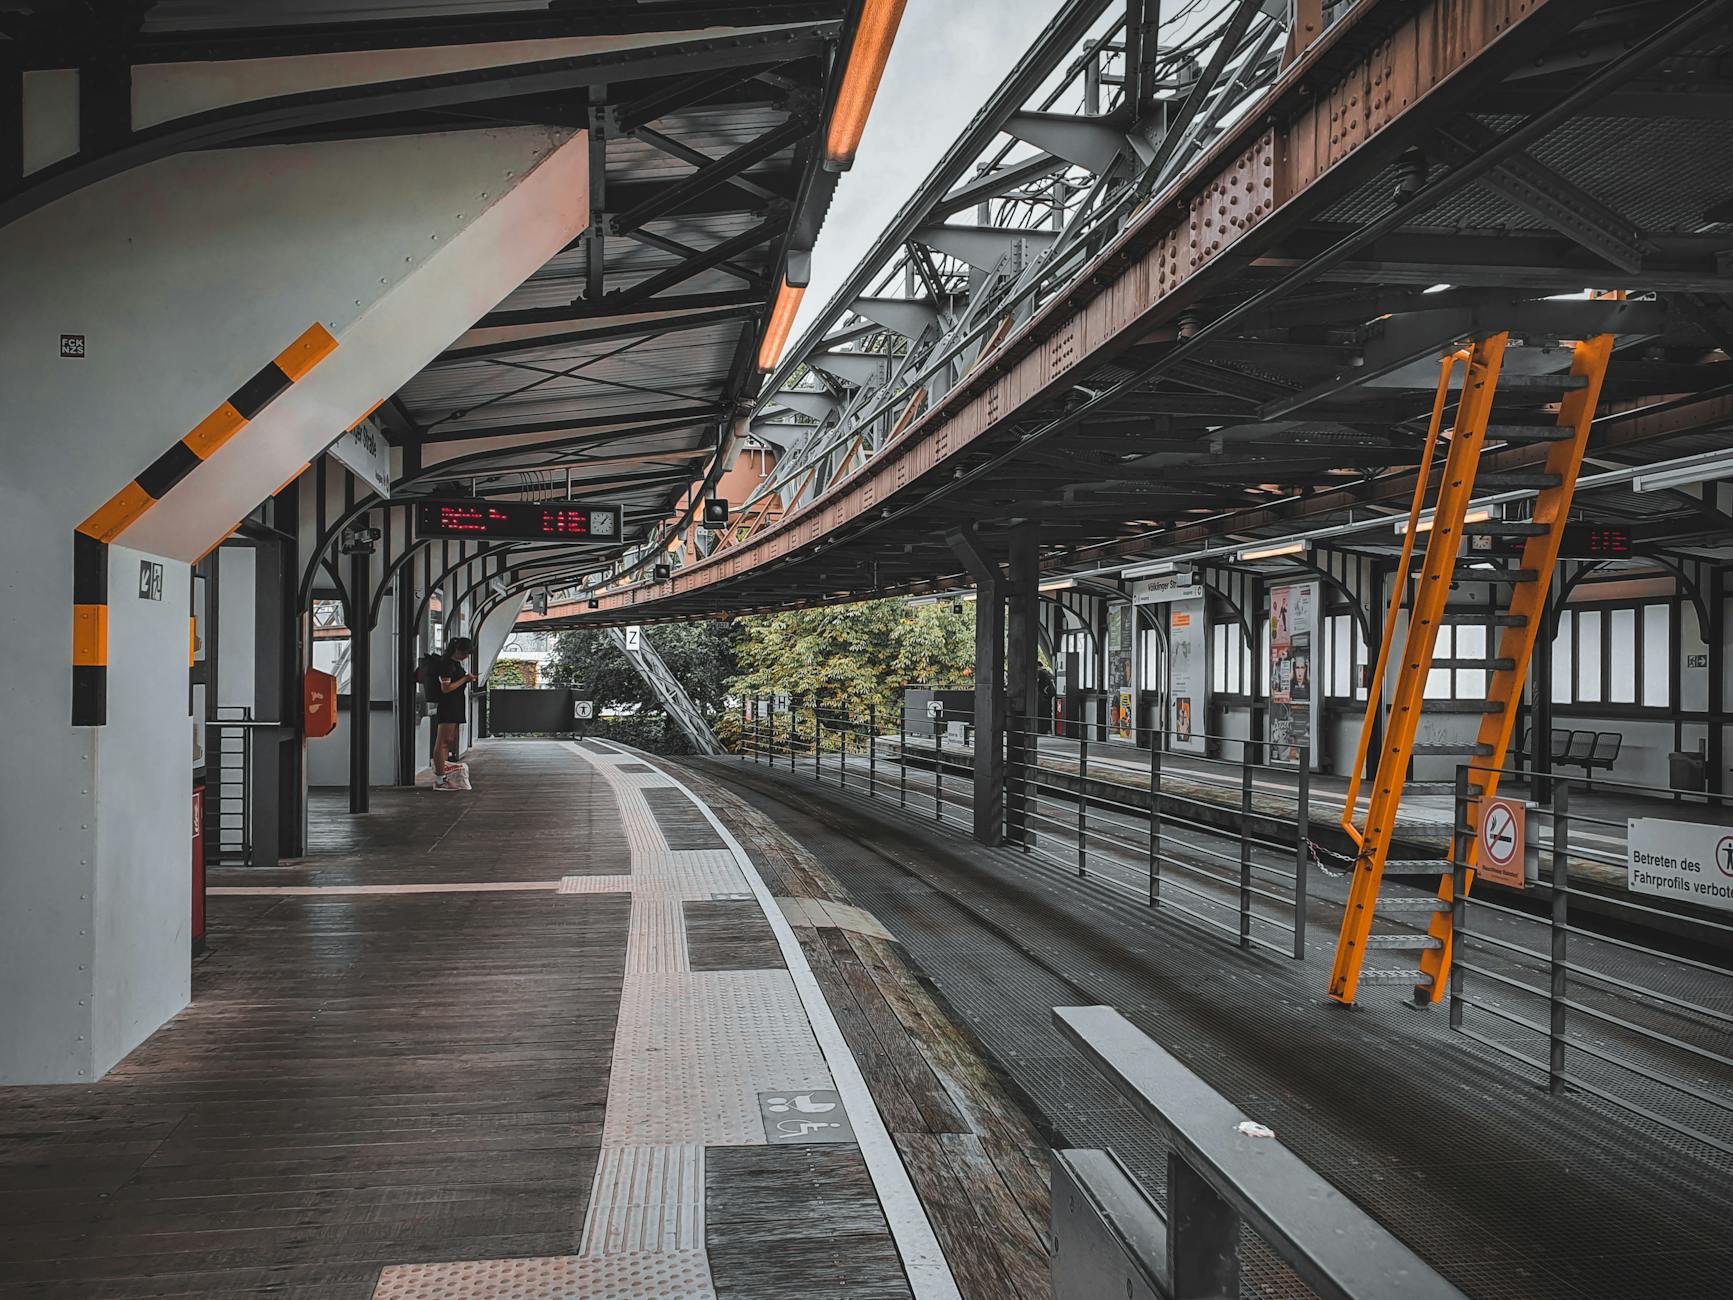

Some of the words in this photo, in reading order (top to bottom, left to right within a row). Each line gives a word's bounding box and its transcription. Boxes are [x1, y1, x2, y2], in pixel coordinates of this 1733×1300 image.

[62, 346, 82, 354] NZS
[629, 631, 637, 644] Z
[778, 696, 786, 709] H
[1633, 851, 1677, 869] Betreten
[1681, 858, 1701, 873] des
[1634, 870, 1690, 891] Fahrprofils
